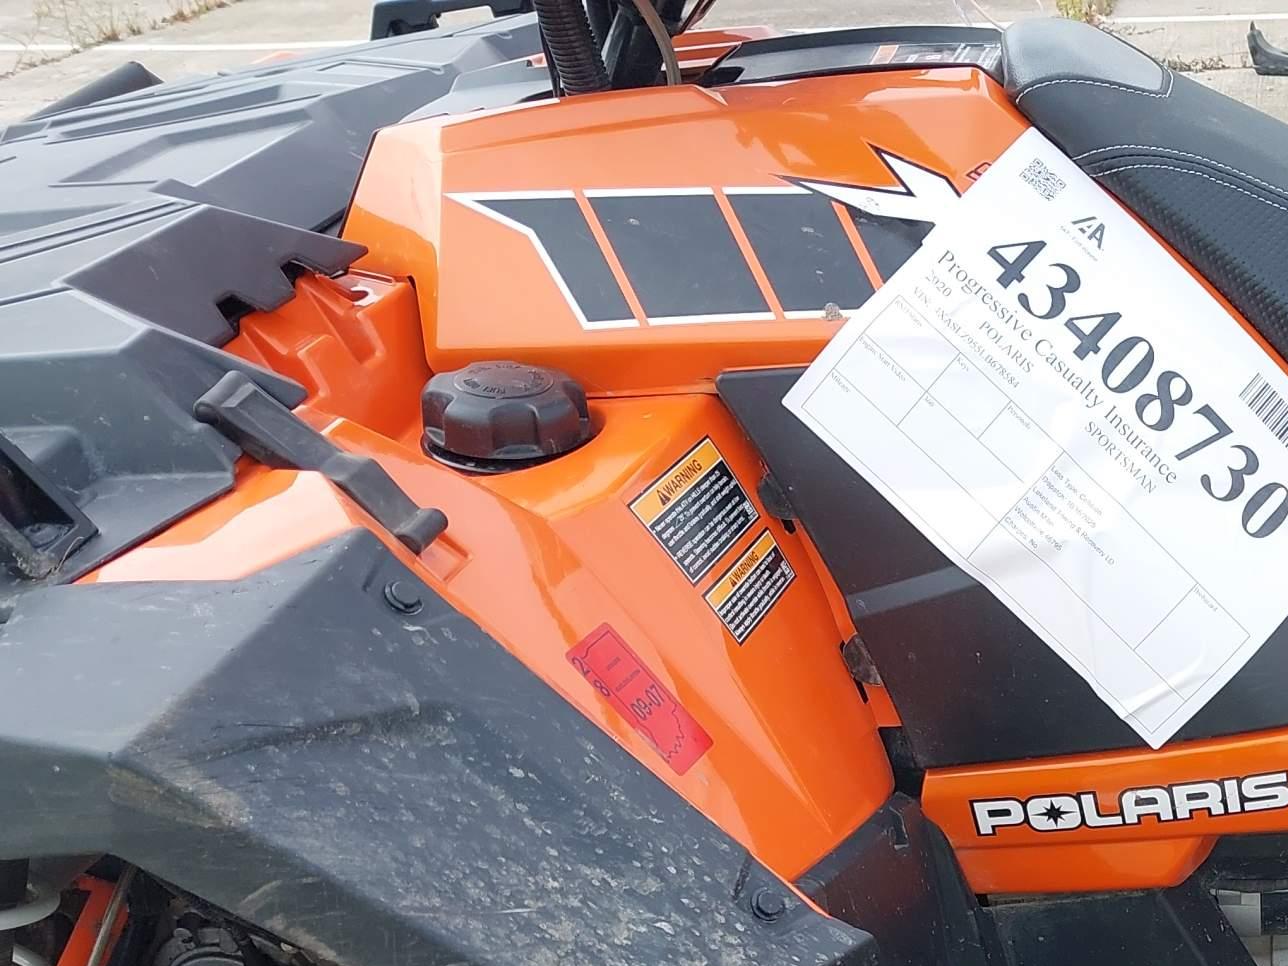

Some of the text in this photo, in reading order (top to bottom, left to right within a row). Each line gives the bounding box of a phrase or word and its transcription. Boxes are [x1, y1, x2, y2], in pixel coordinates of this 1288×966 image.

[933, 248, 1186, 486] Progressive Casualty Insurance
[976, 319, 1036, 375] POLARIS
[1079, 419, 1161, 496] SPORTSMAN
[660, 458, 704, 497] WARNING
[730, 550, 761, 582] WARNING
